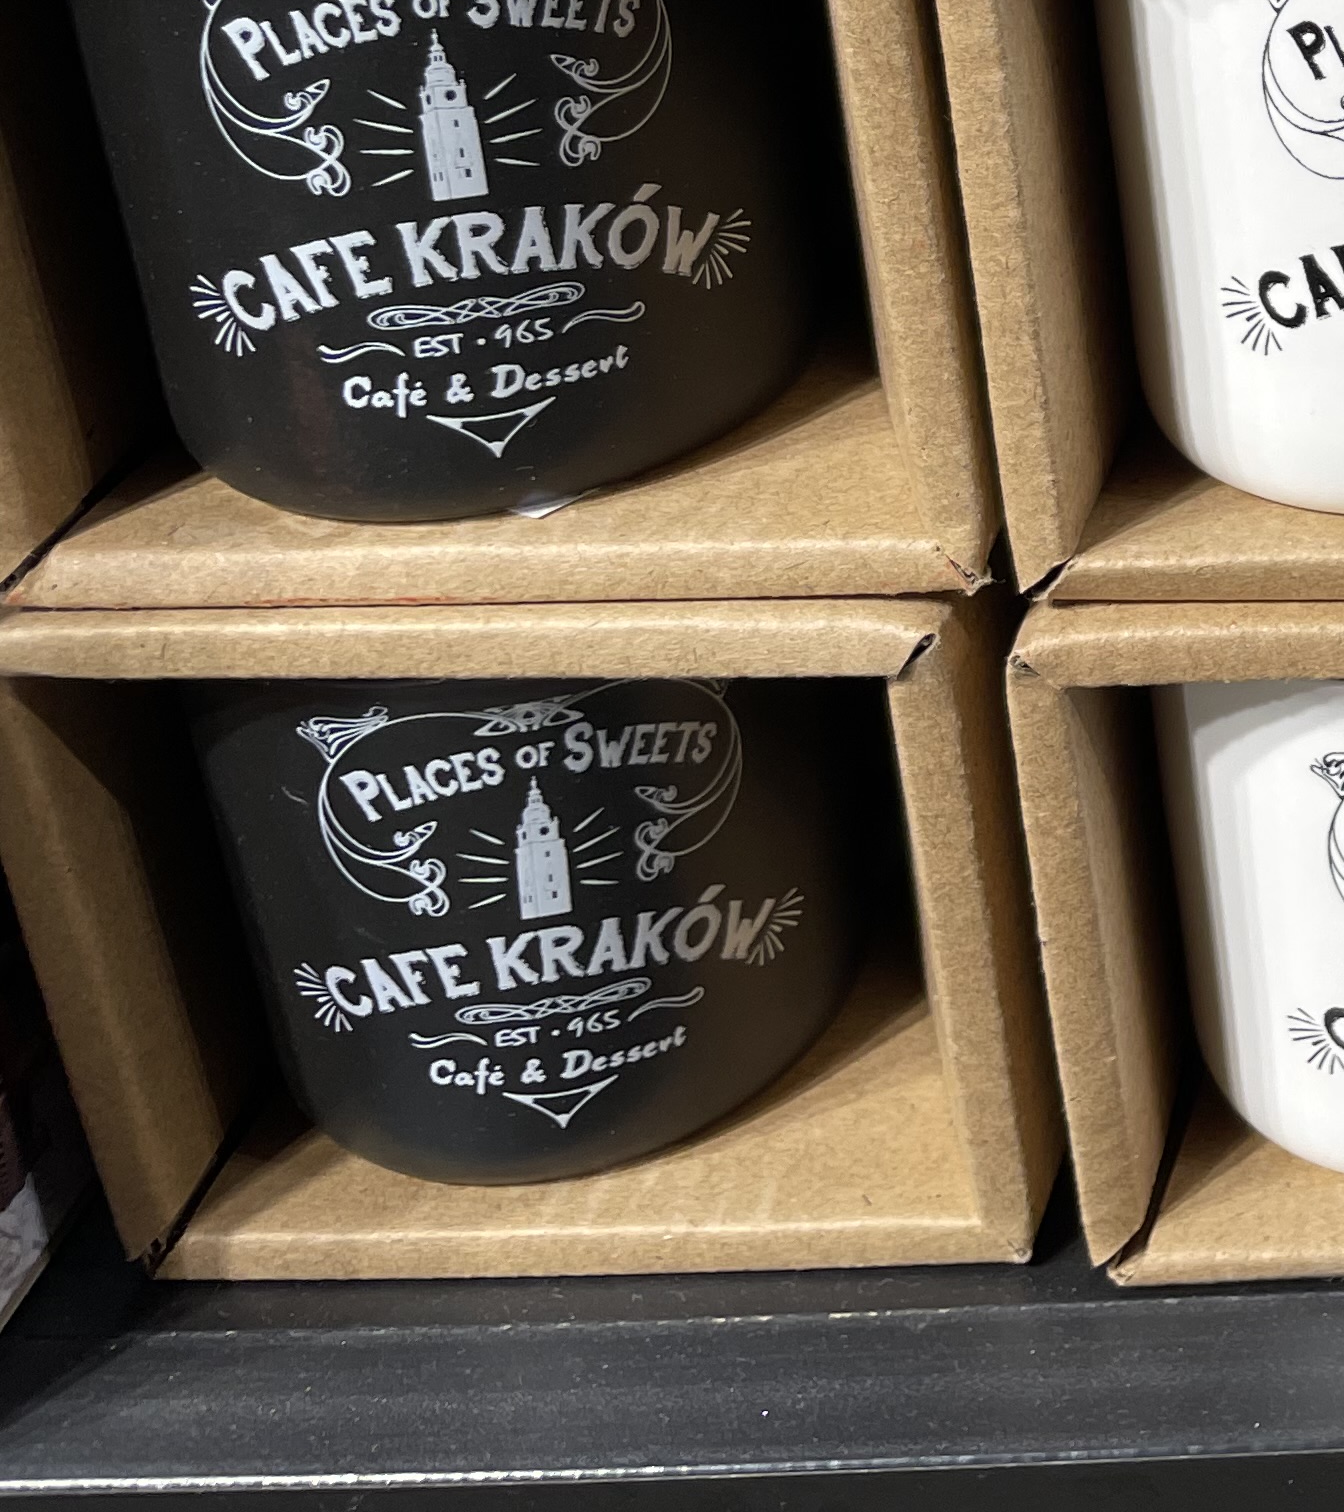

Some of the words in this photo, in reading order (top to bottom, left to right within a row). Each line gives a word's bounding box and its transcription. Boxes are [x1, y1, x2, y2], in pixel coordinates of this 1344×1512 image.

[222, 230, 393, 332] CAFE
[396, 182, 721, 288] KRAKÓW
[495, 319, 554, 348] 965
[343, 372, 428, 417] Café
[445, 373, 474, 404] &
[491, 345, 630, 400] Dessert
[340, 748, 505, 822] PLACES
[515, 741, 555, 770] OF
[563, 721, 718, 773] SWEETS
[325, 944, 481, 1018] CAFE
[486, 883, 776, 991] KRAKÓW
[429, 1058, 505, 1095] Café
[519, 1058, 547, 1085] &
[560, 1026, 687, 1080] Dessert
[568, 1010, 621, 1039] 965
